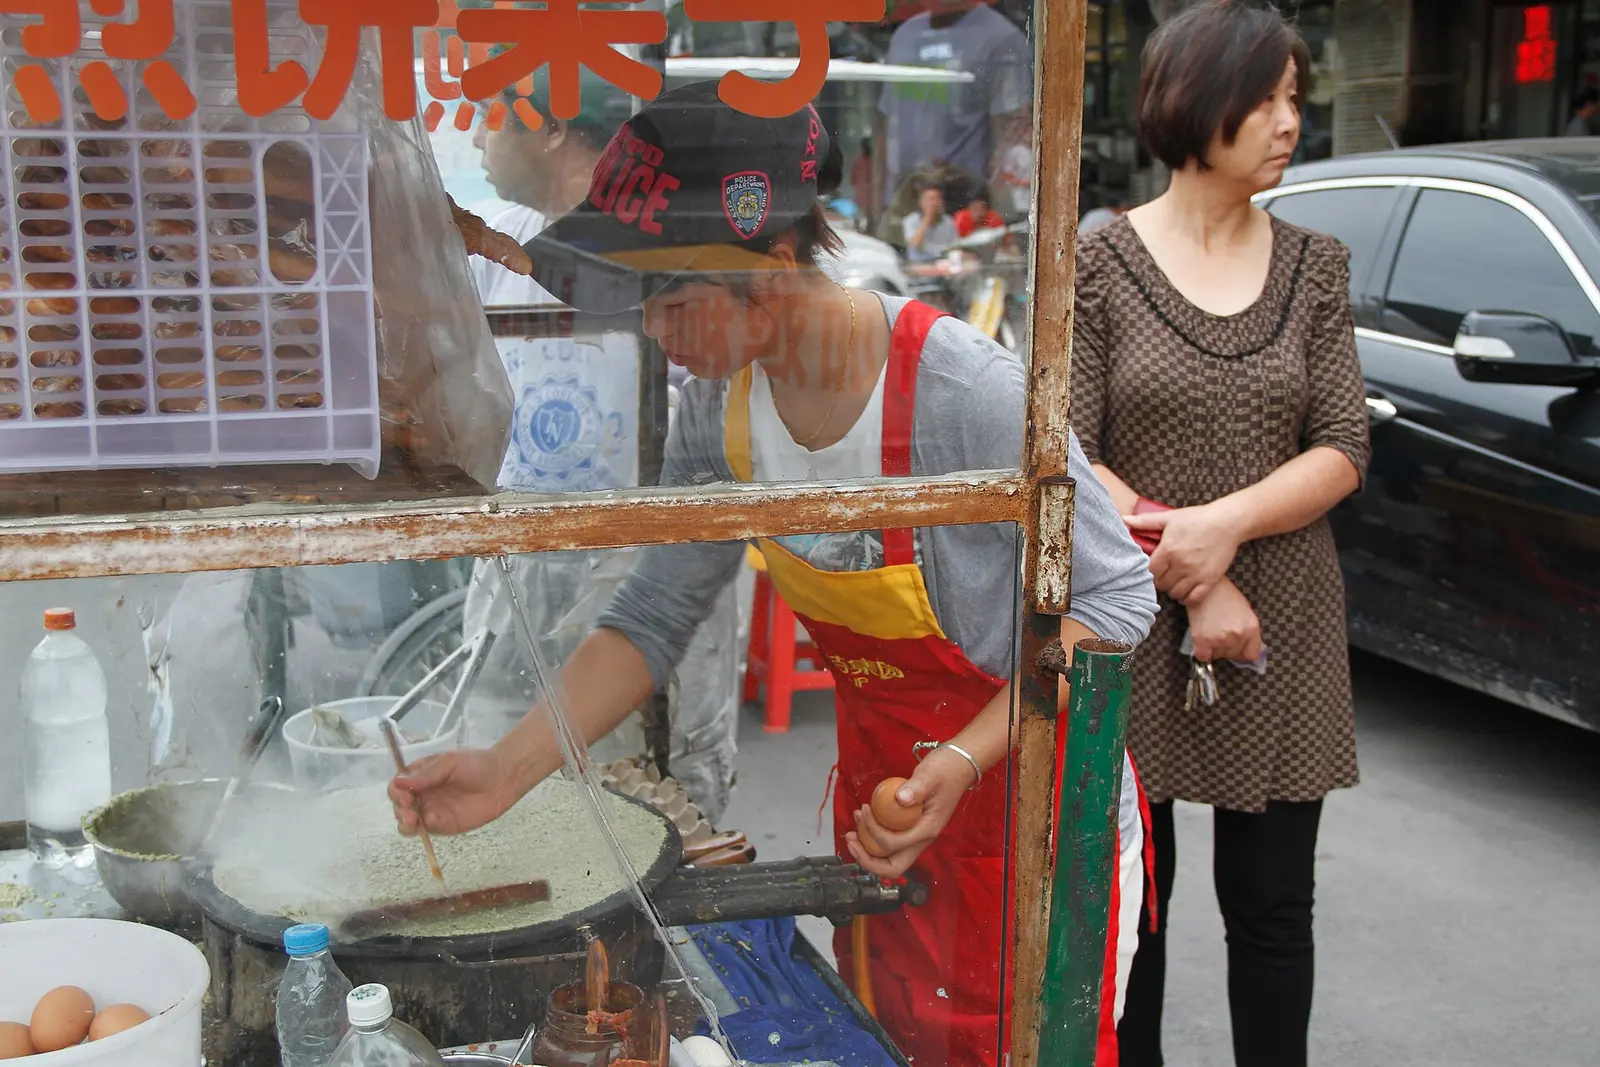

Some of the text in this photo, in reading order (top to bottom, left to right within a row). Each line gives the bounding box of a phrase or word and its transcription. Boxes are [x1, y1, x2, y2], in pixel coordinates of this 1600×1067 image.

[590, 138, 680, 236] LICE
[734, 175, 757, 184] POLICE
[726, 191, 768, 231] CITY OF NEW YORK
